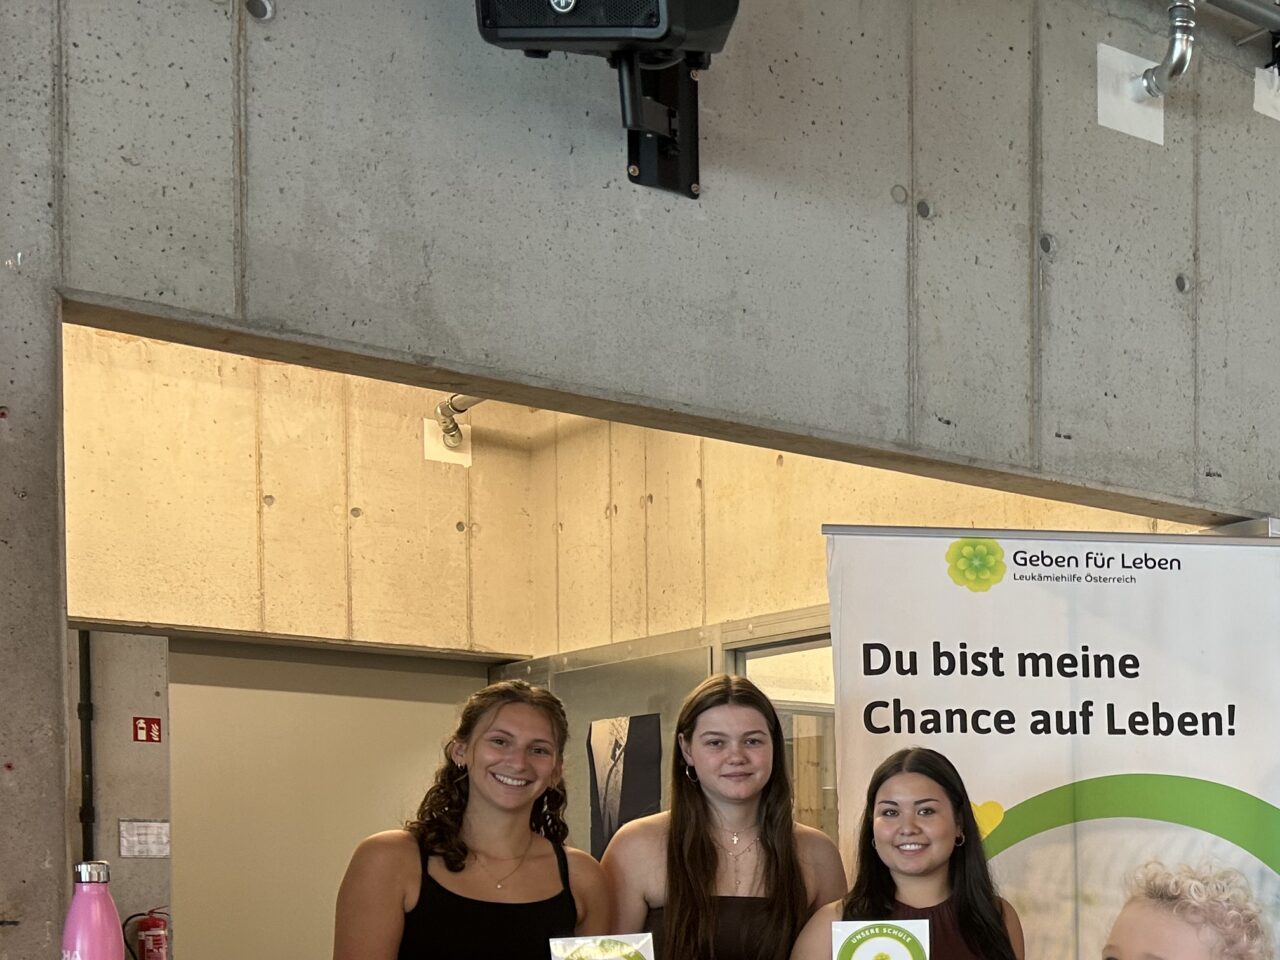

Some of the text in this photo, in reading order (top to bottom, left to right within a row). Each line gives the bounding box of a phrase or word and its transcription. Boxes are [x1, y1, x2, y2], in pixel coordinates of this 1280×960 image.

[1013, 550, 1181, 570] Geben für Leben
[1013, 573, 1136, 584] Leukämiehilfe Österreich
[862, 641, 1140, 678] Du bist meine
[863, 698, 1236, 736] Chance auf Leben!
[851, 927, 912, 944] UNSERE SCHULE
